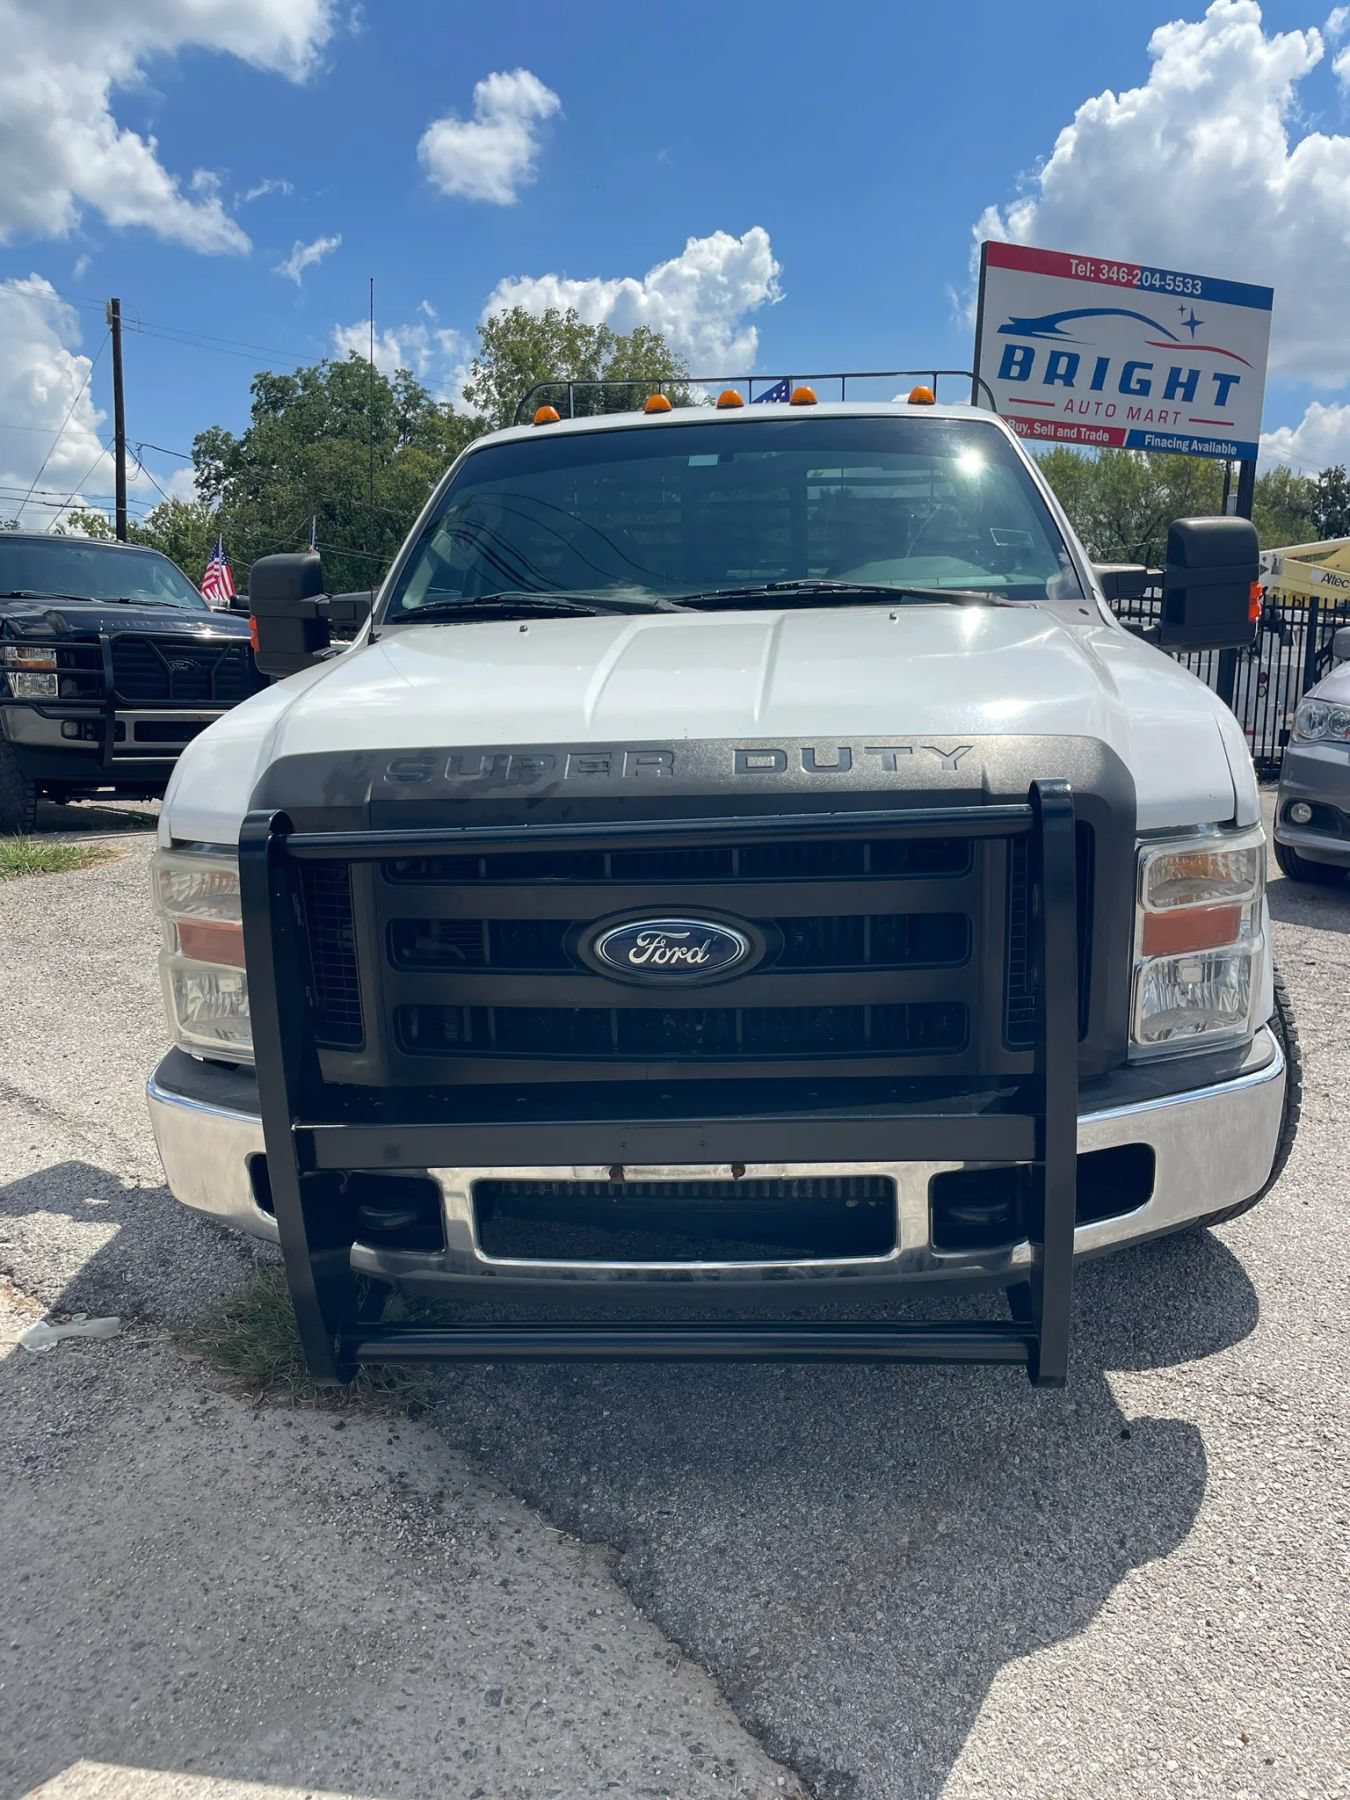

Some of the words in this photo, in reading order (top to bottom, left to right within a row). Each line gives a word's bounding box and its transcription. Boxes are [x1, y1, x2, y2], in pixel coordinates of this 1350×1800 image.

[1070, 259, 1095, 278] Tel:
[1099, 264, 1202, 295] 346-204-5533
[997, 343, 1241, 407] BRIGHT
[1063, 398, 1117, 418] AUTO
[1127, 406, 1182, 425] MART
[1034, 422, 1055, 436] Sell
[1057, 427, 1077, 438] and
[1080, 428, 1110, 442] Trade
[1144, 434, 1189, 453] Finacing
[1190, 440, 1237, 456] Available
[1321, 572, 1350, 588] Altec
[383, 749, 677, 784] SUPER
[734, 745, 975, 775] DUTY
[628, 931, 710, 966] Ford
